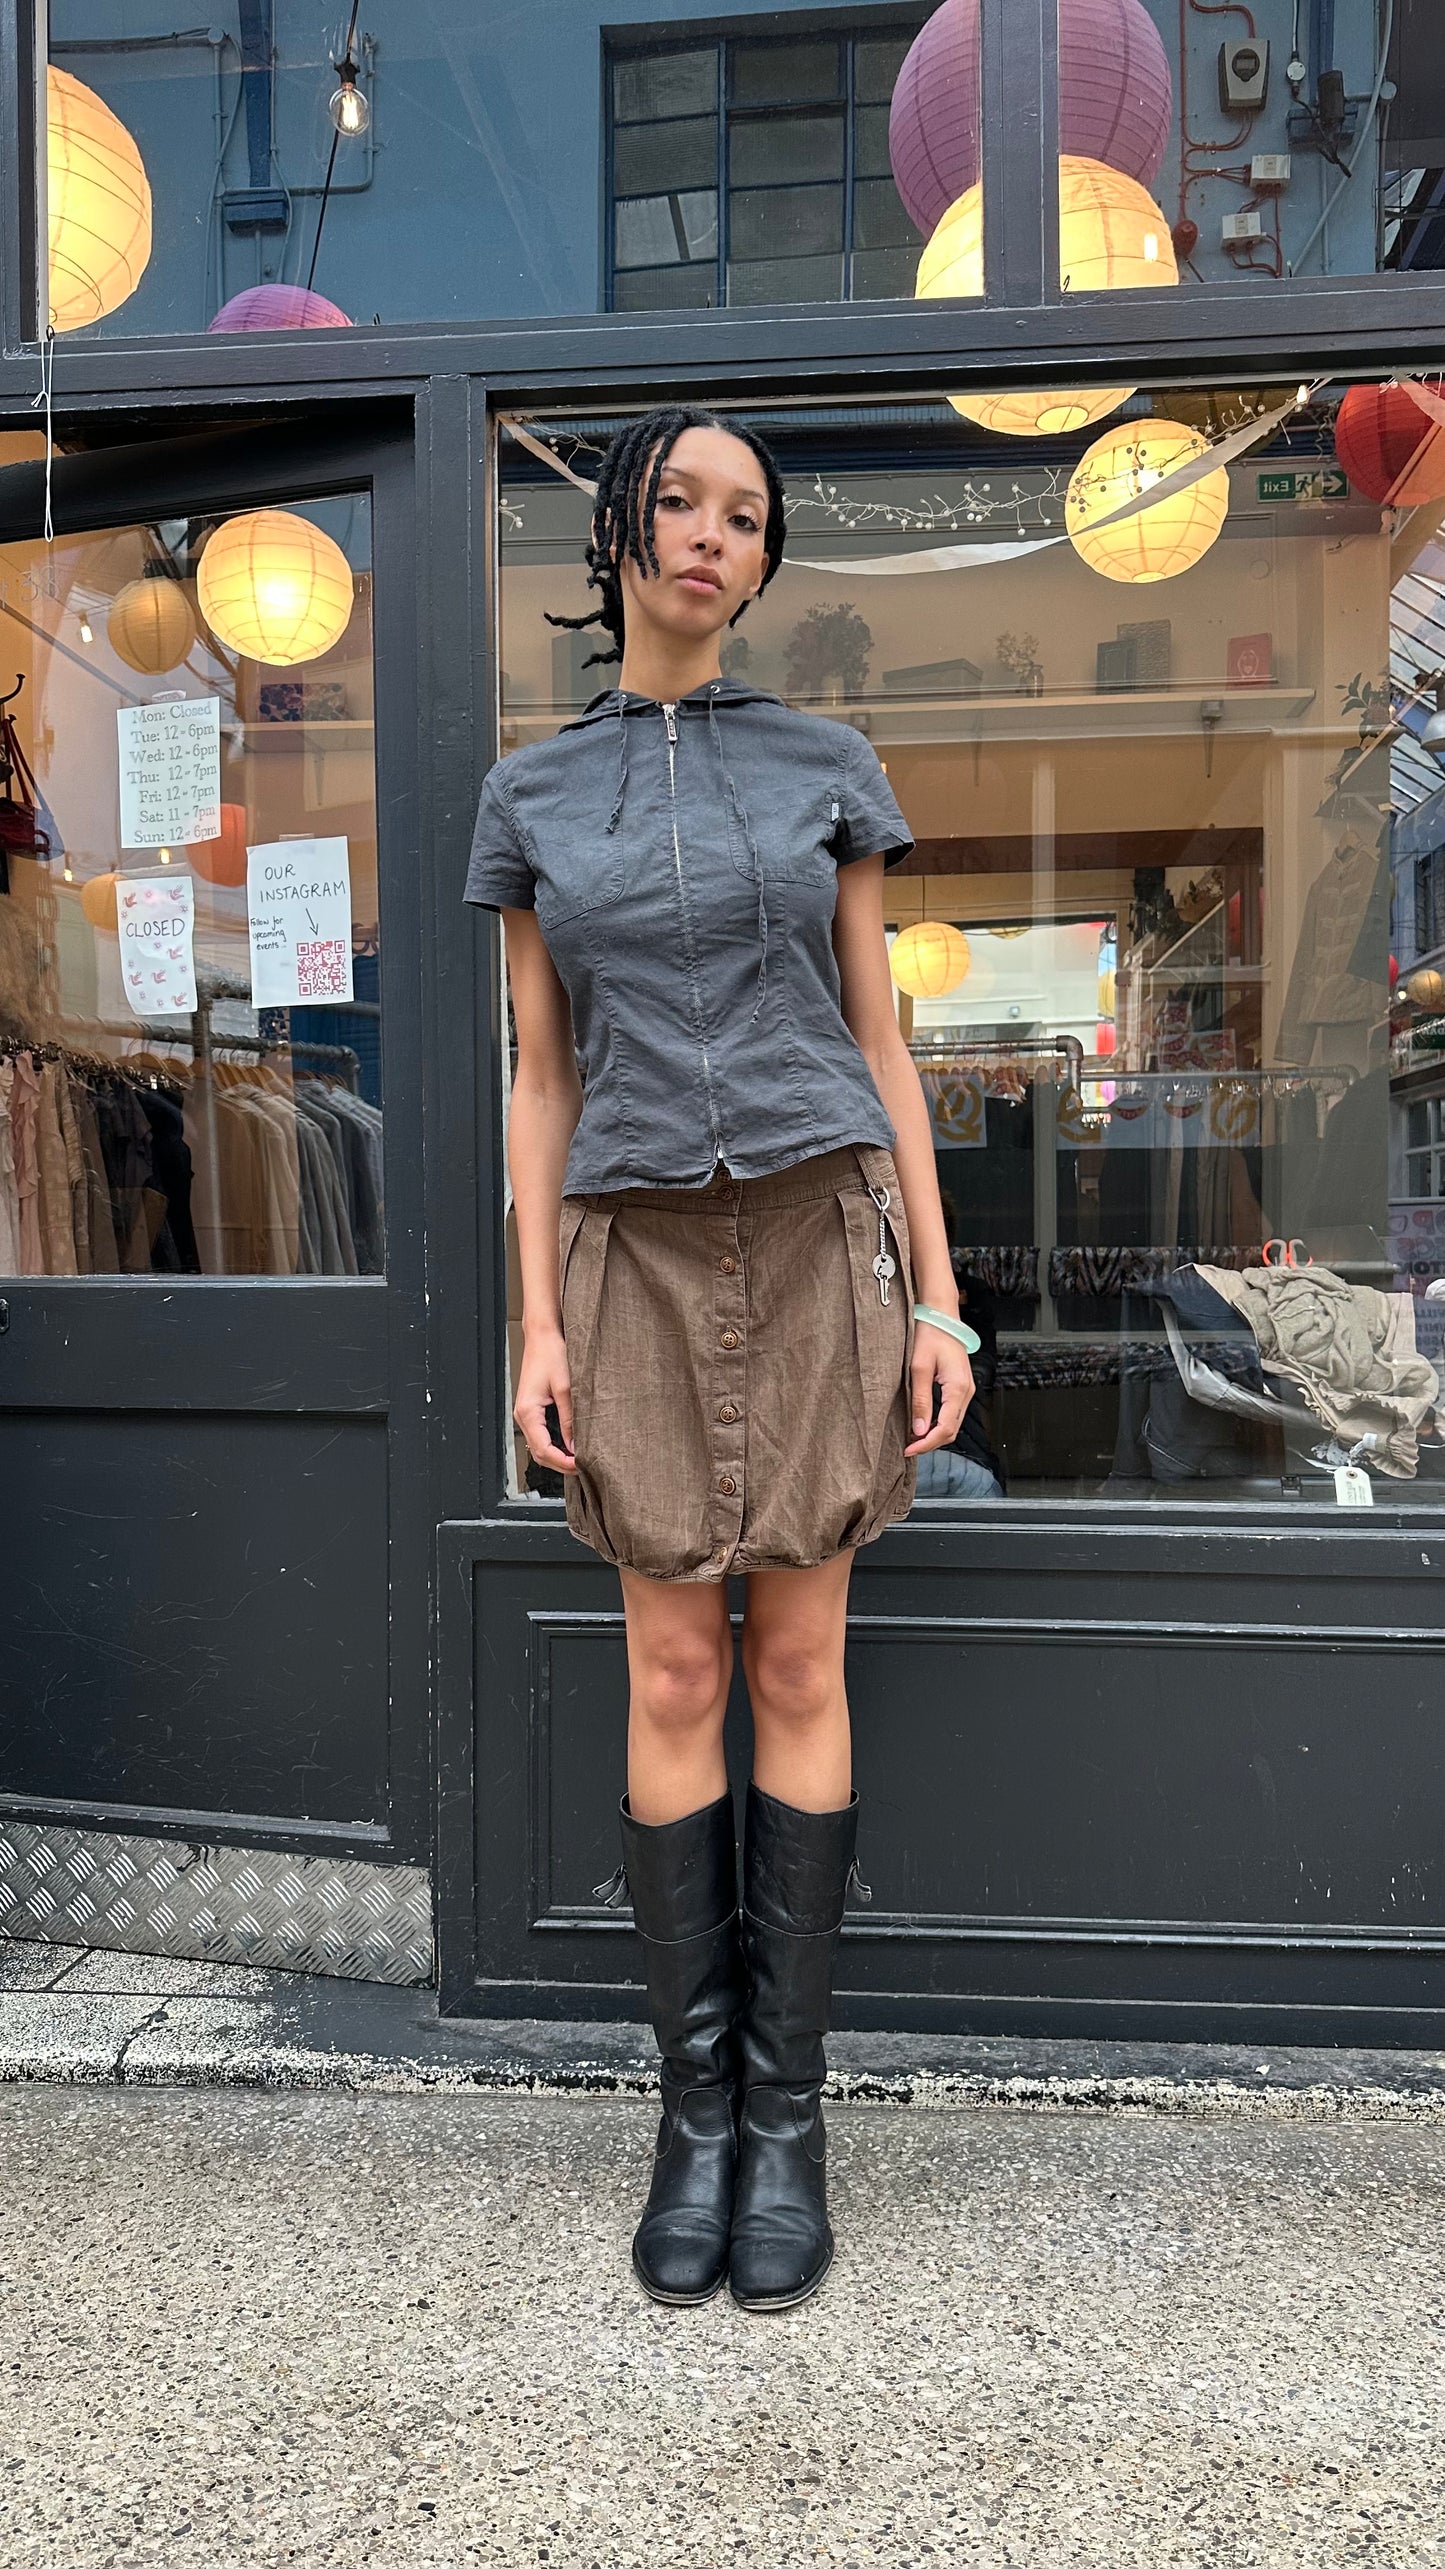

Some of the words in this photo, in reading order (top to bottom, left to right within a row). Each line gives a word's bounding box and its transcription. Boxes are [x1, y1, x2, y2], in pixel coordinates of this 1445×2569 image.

[132, 709, 166, 724] Mon:
[169, 702, 212, 719] Closed
[130, 730, 160, 744] Tue:
[129, 748, 165, 764] Wed:
[127, 770, 160, 784] Thu:
[139, 790, 162, 803] Fri:
[139, 810, 164, 823] Sat:
[134, 830, 165, 843] Sun:
[264, 863, 296, 881] OUR
[260, 880, 346, 903] INSTAGRAM
[125, 918, 185, 938] CLOSED
[272, 915, 284, 931] for
[252, 929, 287, 943] upcoming
